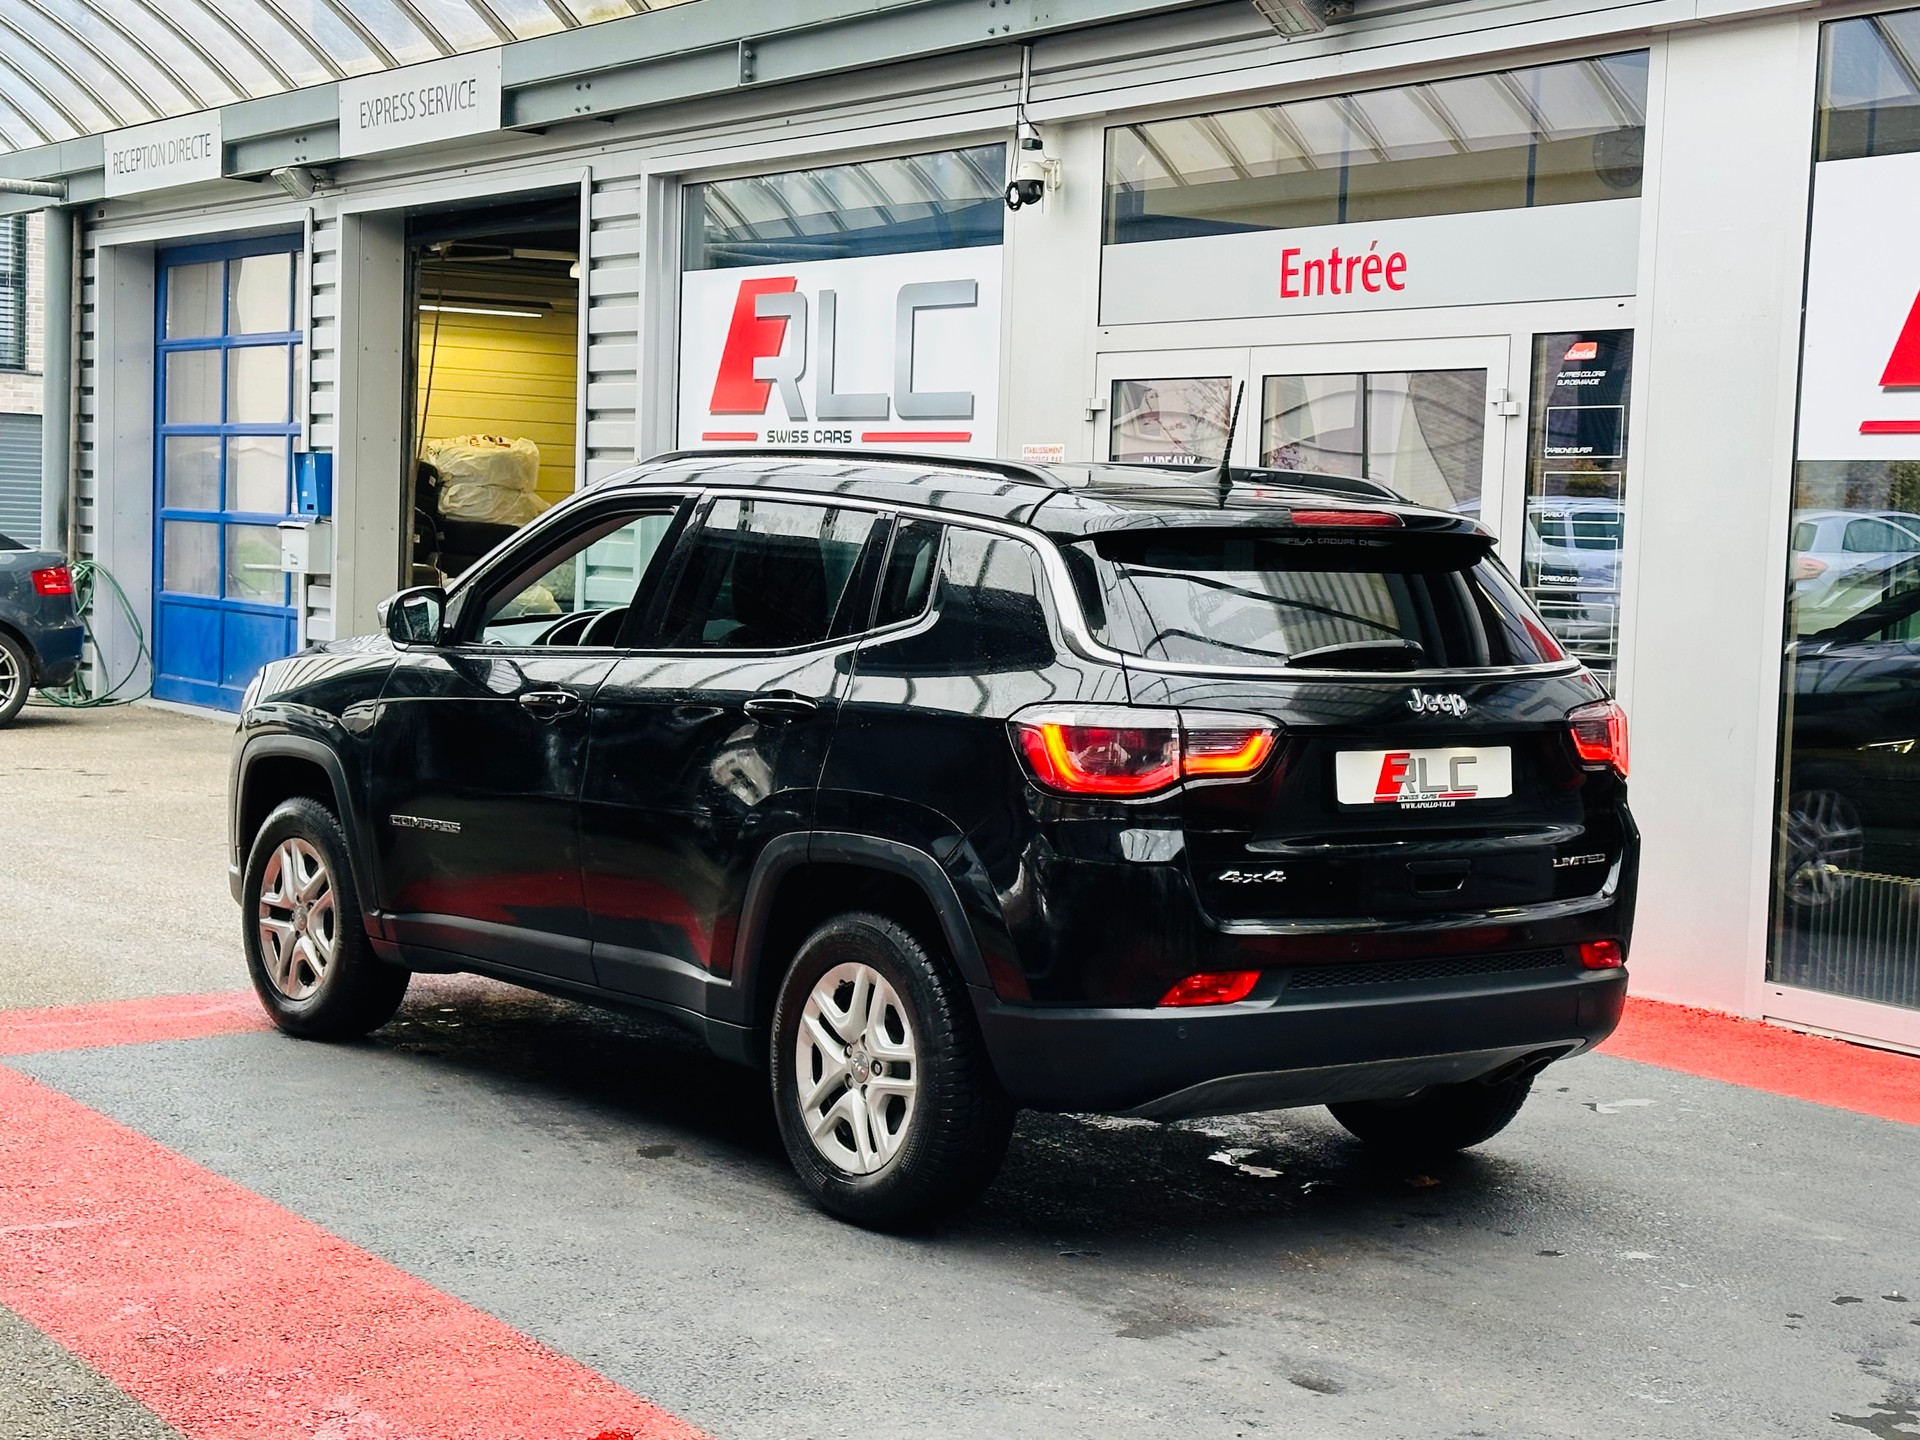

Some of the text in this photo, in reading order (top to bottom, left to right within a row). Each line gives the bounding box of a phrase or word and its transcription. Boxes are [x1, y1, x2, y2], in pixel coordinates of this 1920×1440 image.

[359, 78, 476, 129] EXPRESS SERVICE
[112, 132, 212, 176] RECEPTION DIRECTE
[1280, 240, 1407, 298] Entrée
[767, 430, 852, 443] SWISS CARS
[1406, 688, 1468, 717] Jeep
[389, 814, 461, 833] COMPASS
[1552, 853, 1605, 868] LIMITED
[1219, 870, 1287, 883] 4x4
